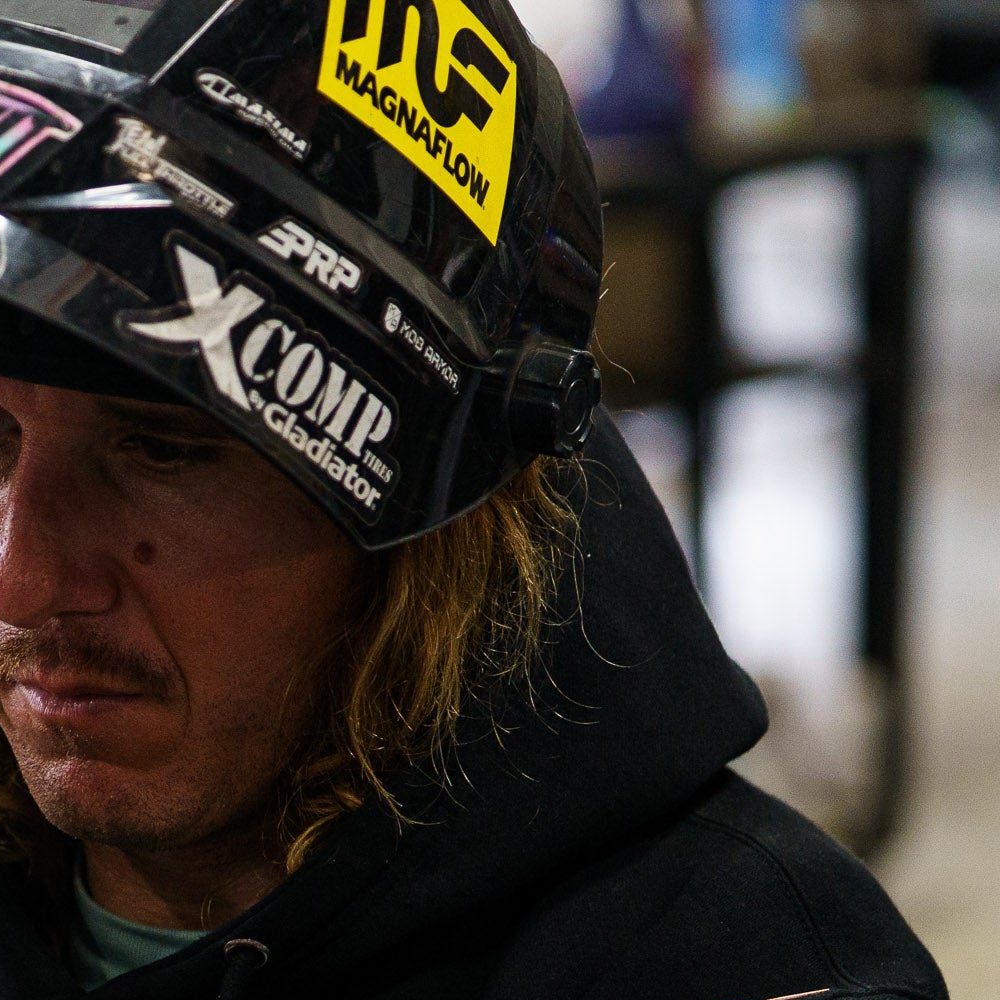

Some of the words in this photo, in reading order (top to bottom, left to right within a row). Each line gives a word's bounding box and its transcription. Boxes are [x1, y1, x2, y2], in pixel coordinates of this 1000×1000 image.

[335, 49, 490, 208] MAGNAFLOW
[258, 220, 361, 291] PRP
[262, 402, 381, 507] Gladiator
[361, 448, 393, 483] TIRES
